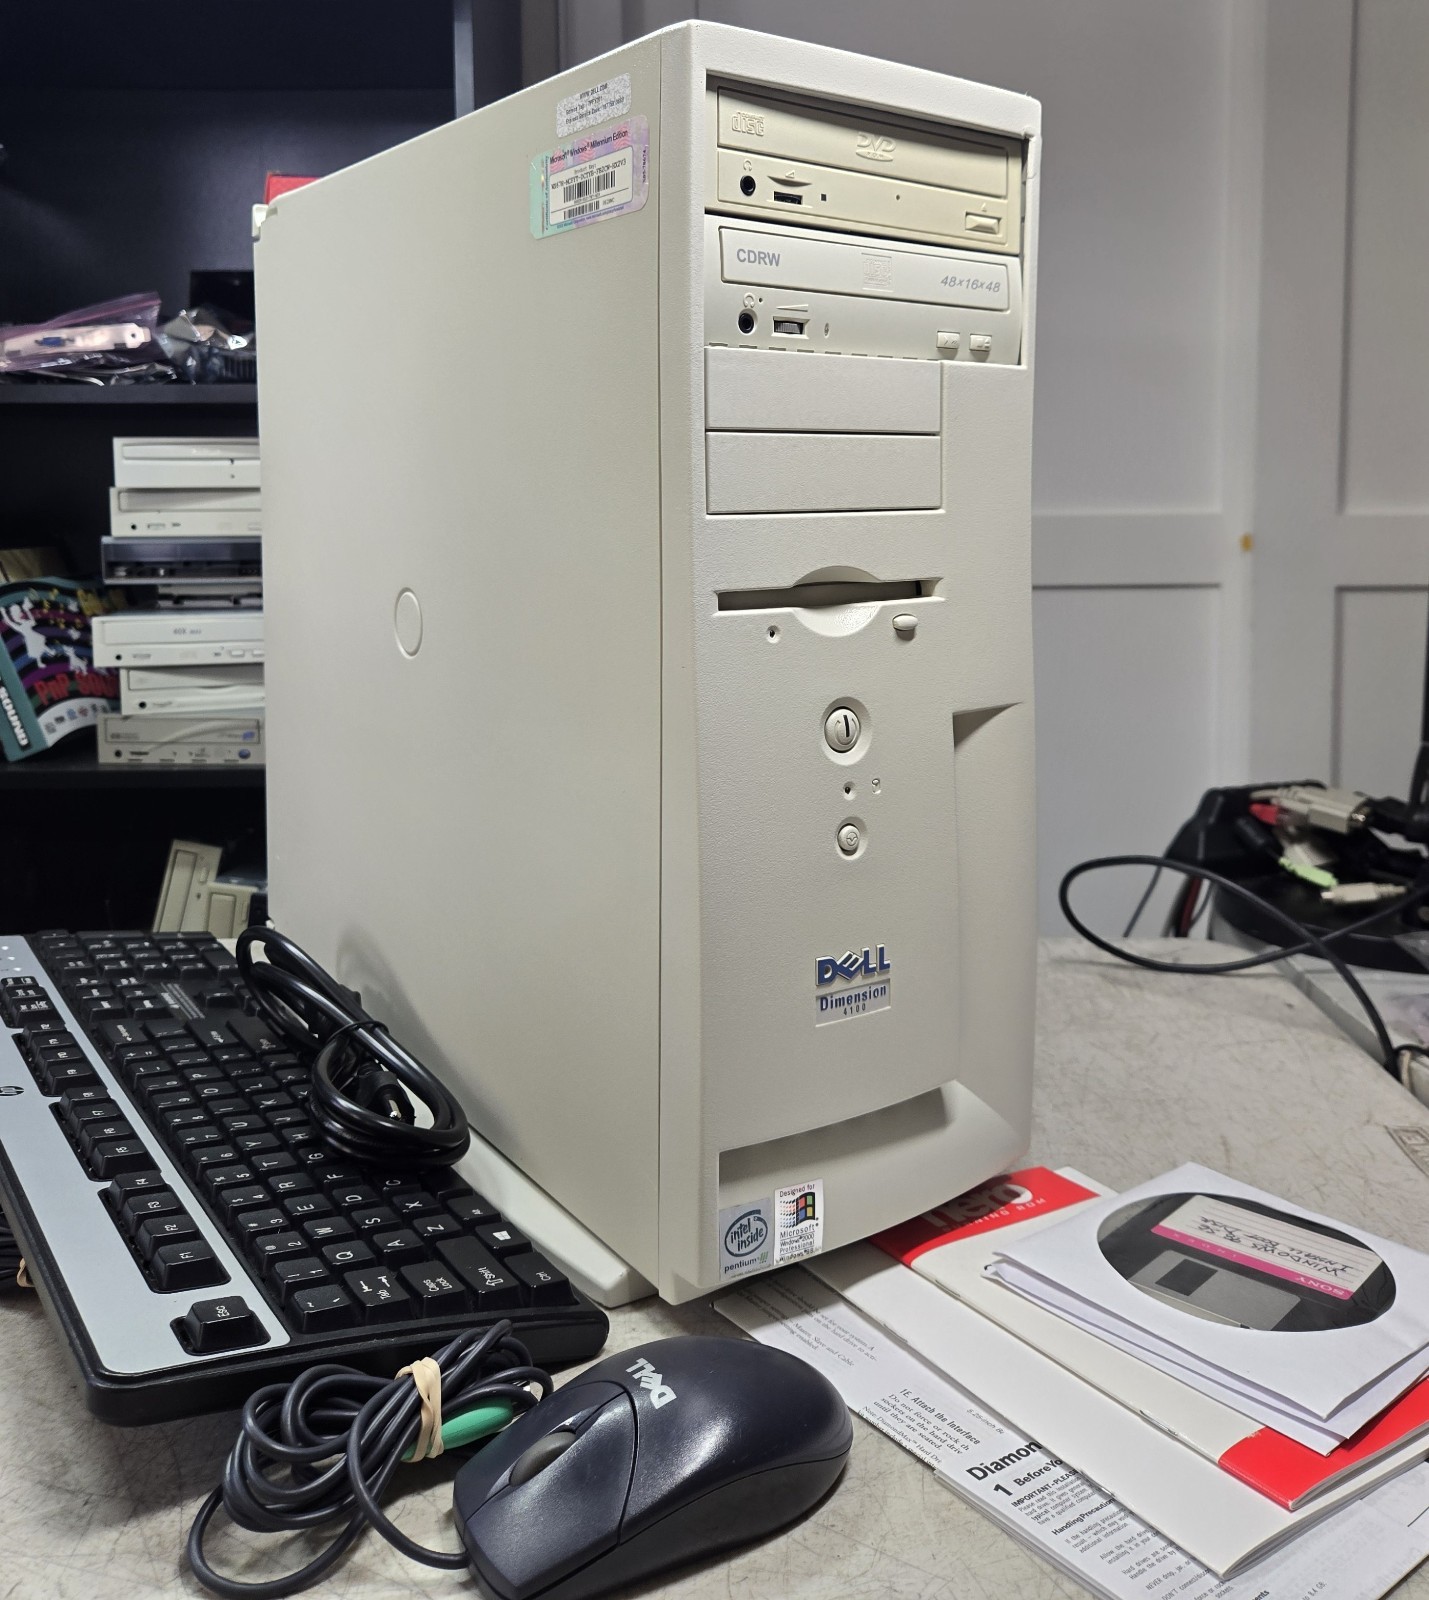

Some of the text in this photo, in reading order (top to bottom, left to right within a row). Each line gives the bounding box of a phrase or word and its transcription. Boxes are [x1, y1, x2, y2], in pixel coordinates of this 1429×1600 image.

[613, 130, 628, 141] Edition
[857, 131, 896, 152] DVD
[736, 248, 781, 267] CDRW
[815, 943, 891, 986] DELL
[820, 986, 886, 1012] Dimension
[843, 1003, 866, 1016] 4100
[246, 1140, 261, 1148] Y
[263, 1160, 279, 1168] T
[327, 1173, 344, 1181] F
[385, 1179, 401, 1187] C
[279, 1181, 296, 1189] R
[346, 1194, 363, 1203] D
[780, 1186, 806, 1198] Designed
[297, 1203, 315, 1211] E
[365, 1217, 381, 1225] S
[165, 1224, 178, 1232] F2
[314, 1226, 333, 1235] W
[427, 1224, 445, 1232] Z
[730, 1218, 751, 1243] intel
[780, 1223, 815, 1239] Microsoft
[388, 1239, 405, 1248] A
[738, 1227, 764, 1251] inside
[780, 1240, 814, 1253] Professional
[179, 1251, 193, 1259] F1
[336, 1251, 354, 1260] Q
[724, 1258, 757, 1274] pentium
[1294, 1275, 1345, 1295] SONY
[626, 1358, 677, 1409] DELL
[880, 1397, 906, 1414] sockets
[904, 1414, 916, 1422] on
[915, 1421, 930, 1431] the
[928, 1430, 948, 1443] hard
[887, 1393, 902, 1403] Do
[900, 1402, 914, 1411] not
[912, 1411, 934, 1424] force
[941, 1430, 961, 1443] rock
[910, 1395, 937, 1413] Attach
[933, 1411, 950, 1422] the
[946, 1420, 983, 1445] Interface
[872, 1400, 944, 1450] until they are seated.
[966, 1440, 1043, 1481] Diamon
[993, 1483, 1013, 1497] 1
[1030, 1508, 1051, 1521] typical
